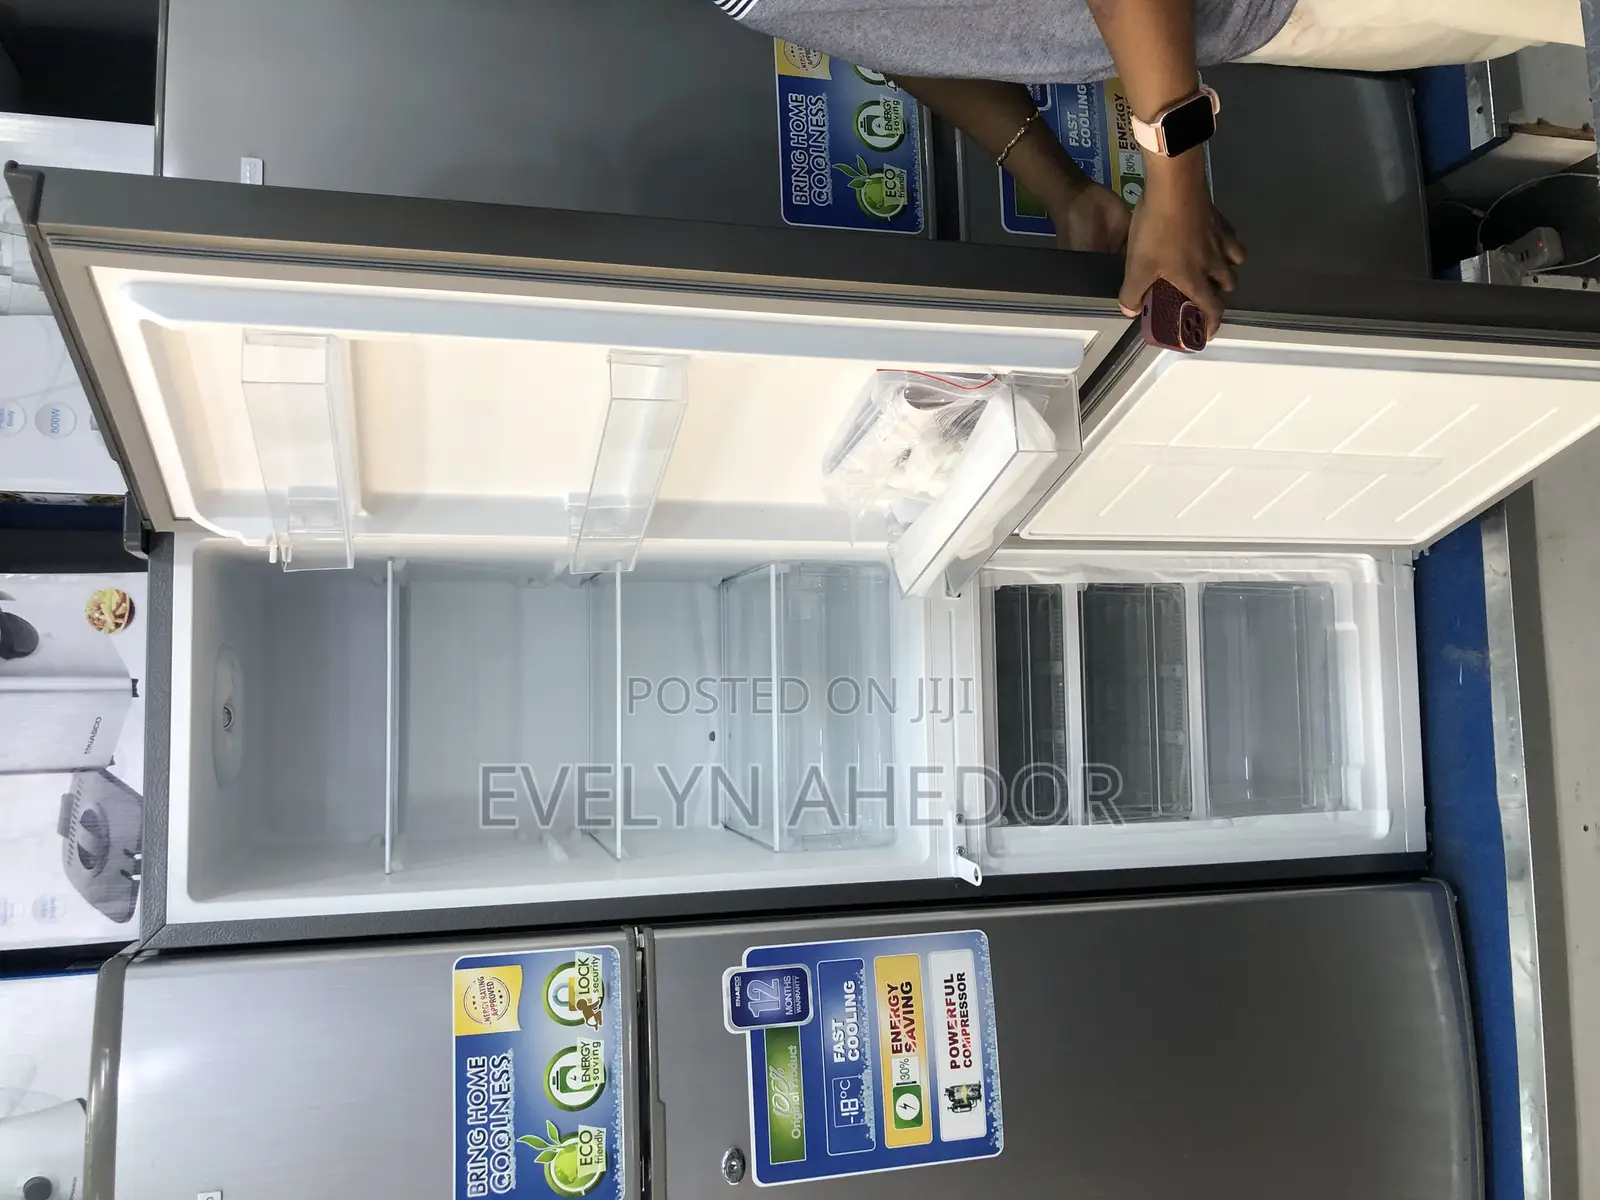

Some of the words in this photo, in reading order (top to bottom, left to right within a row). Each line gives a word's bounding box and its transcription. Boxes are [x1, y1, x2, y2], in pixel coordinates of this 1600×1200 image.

[789, 93, 807, 149] HOME
[883, 98, 893, 131] ENERGY
[892, 100, 901, 132] saving
[1067, 111, 1079, 146] FAST
[1077, 84, 1091, 148] COOLING
[1114, 93, 1128, 150] ENERGY
[808, 93, 829, 207] COOLNESS
[1125, 154, 1135, 172] 30%
[792, 153, 809, 206] BRING
[884, 169, 897, 197] ECO
[897, 170, 906, 198] friendly
[50, 408, 60, 435] 500W
[477, 976, 487, 1000] RATING
[578, 956, 590, 995] LOCK
[592, 956, 601, 994] security
[783, 975, 794, 1016] MONTHS
[486, 981, 499, 1016] APPROVED
[747, 979, 781, 1018] 12
[887, 983, 903, 1055] ENERGY
[900, 981, 916, 1052] SAVING
[833, 1019, 846, 1063] FAST
[844, 980, 859, 1062] COOLING
[944, 973, 961, 1070] POWERFUL
[957, 972, 973, 1068] COMPRESSOR
[581, 1041, 591, 1083] ENERGY
[593, 1041, 602, 1081] saving
[788, 1045, 800, 1089] Product
[900, 1058, 910, 1080] 30%
[467, 1056, 487, 1123] HOME
[769, 1065, 790, 1118] 100%
[489, 1052, 513, 1195] COOLNESS
[790, 1092, 802, 1139] Original
[467, 1127, 488, 1198] BRING
[580, 1130, 593, 1166] ECO
[595, 1129, 605, 1165] friendly
